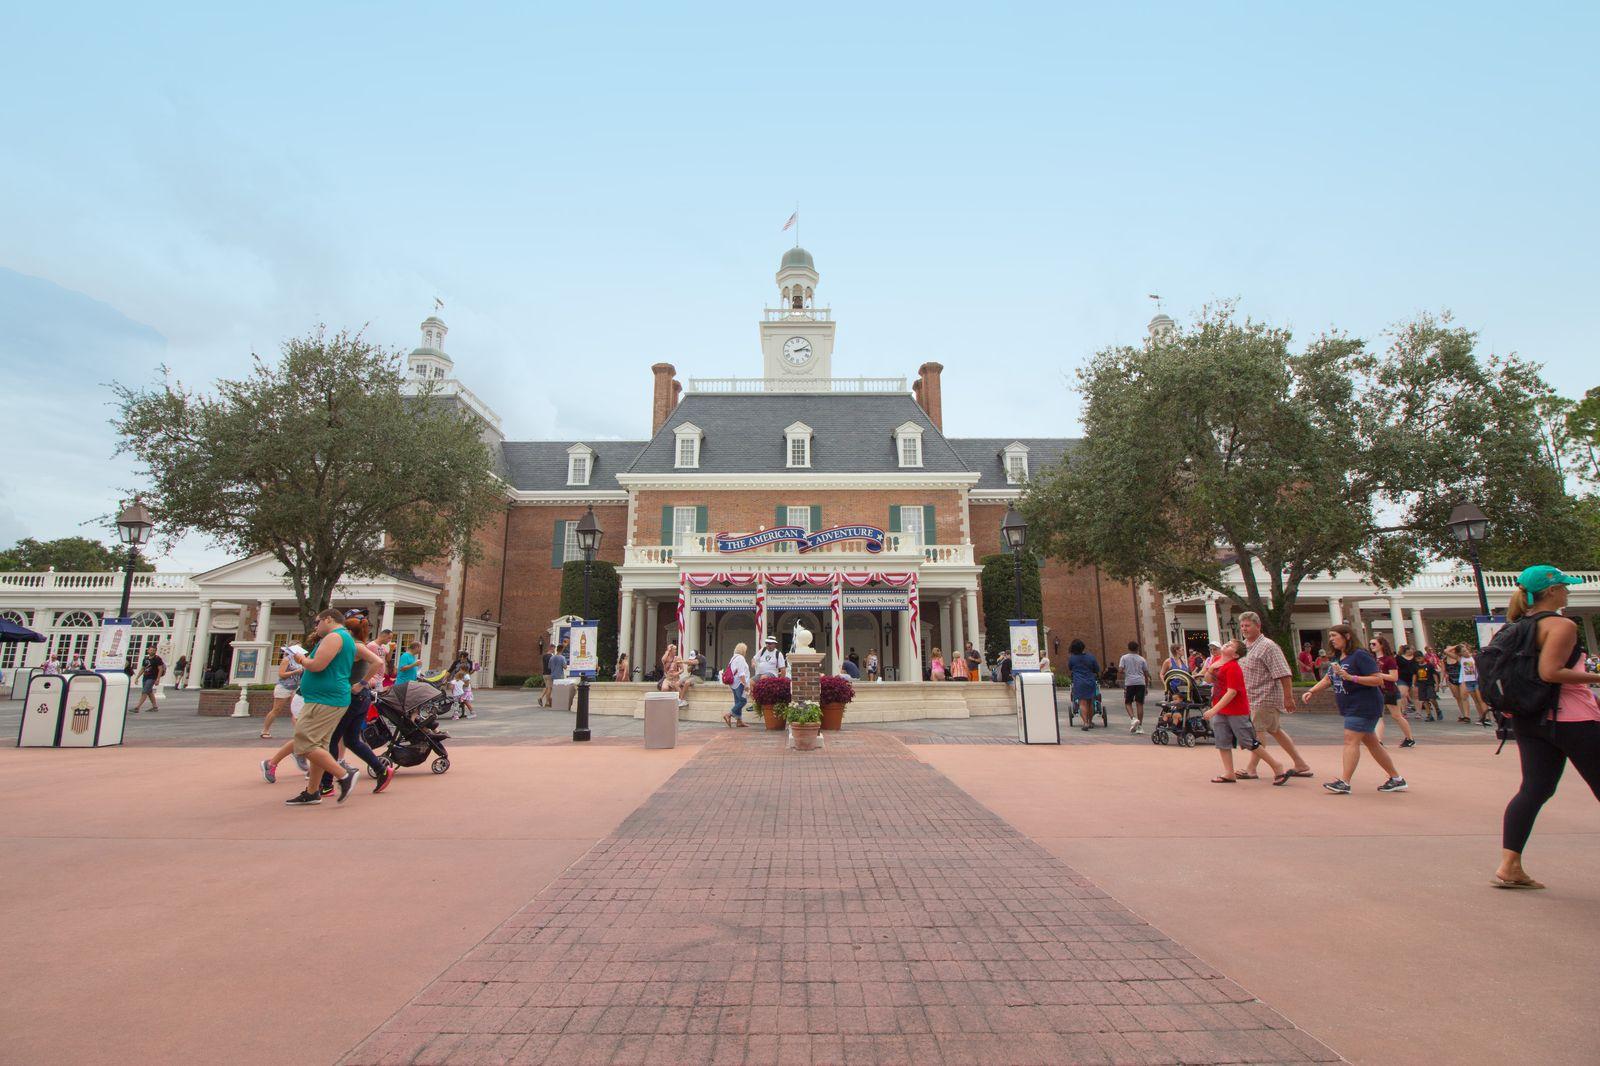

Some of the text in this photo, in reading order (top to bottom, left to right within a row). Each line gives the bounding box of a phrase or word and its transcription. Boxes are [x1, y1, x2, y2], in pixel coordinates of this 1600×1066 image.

[726, 527, 874, 549] THE AMERICAN ADVENTURE
[725, 597, 754, 605] Showing
